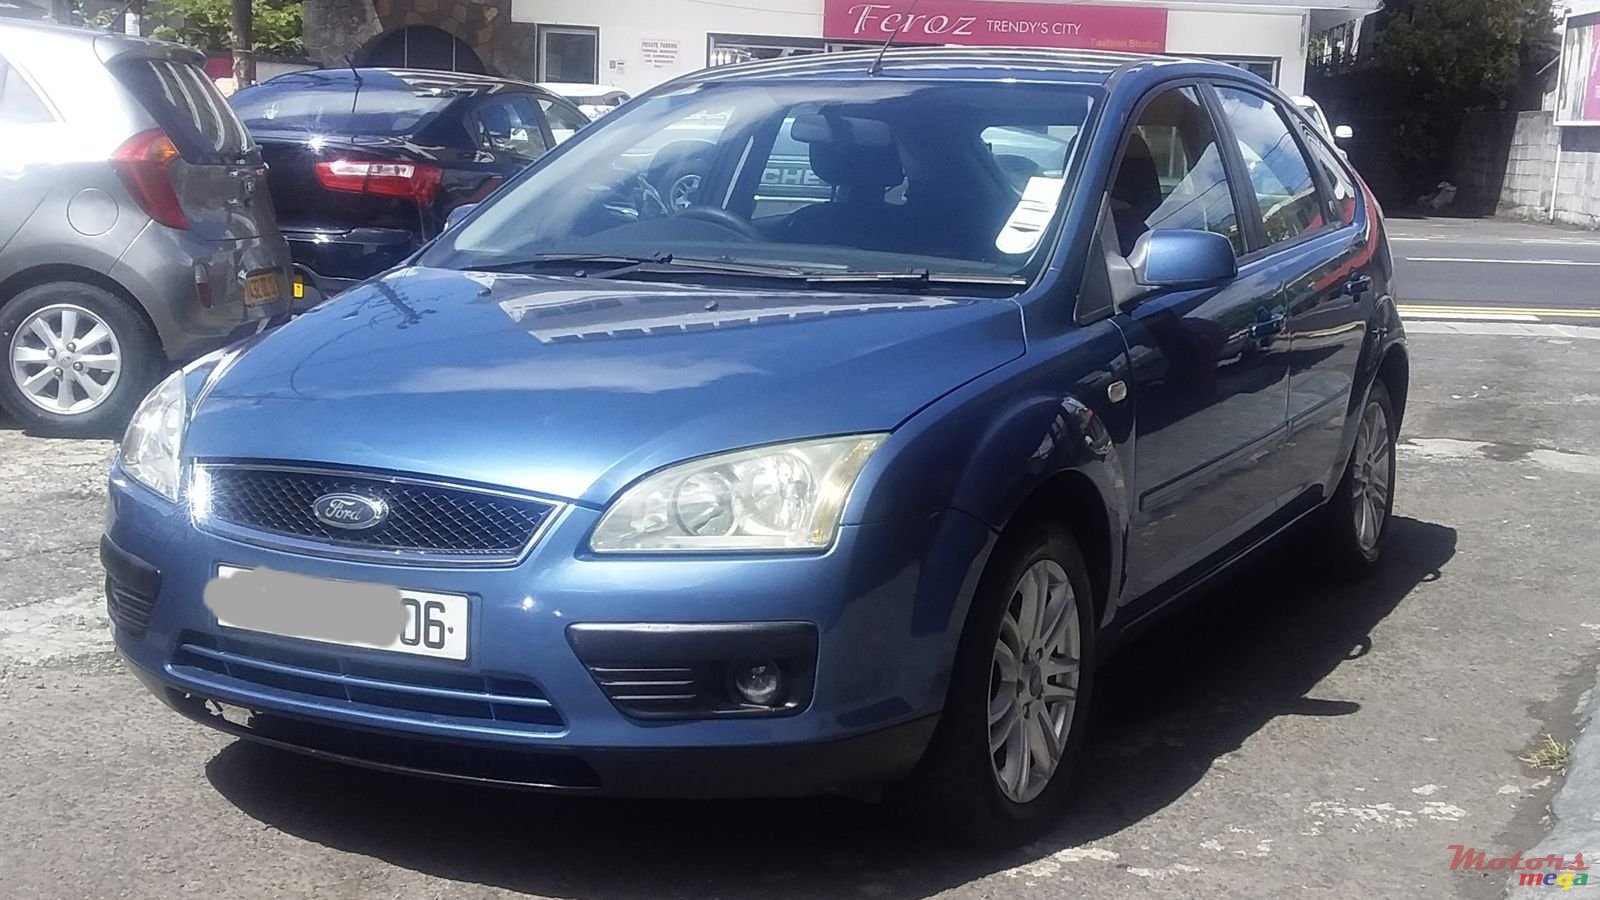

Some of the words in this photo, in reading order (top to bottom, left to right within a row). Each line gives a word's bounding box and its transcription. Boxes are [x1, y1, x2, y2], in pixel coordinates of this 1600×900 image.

[848, 4, 977, 36] Feroz
[986, 19, 1049, 34] TRENDY'S
[1052, 22, 1081, 35] CITY
[1128, 39, 1159, 49] Studio
[325, 498, 365, 521] Ford
